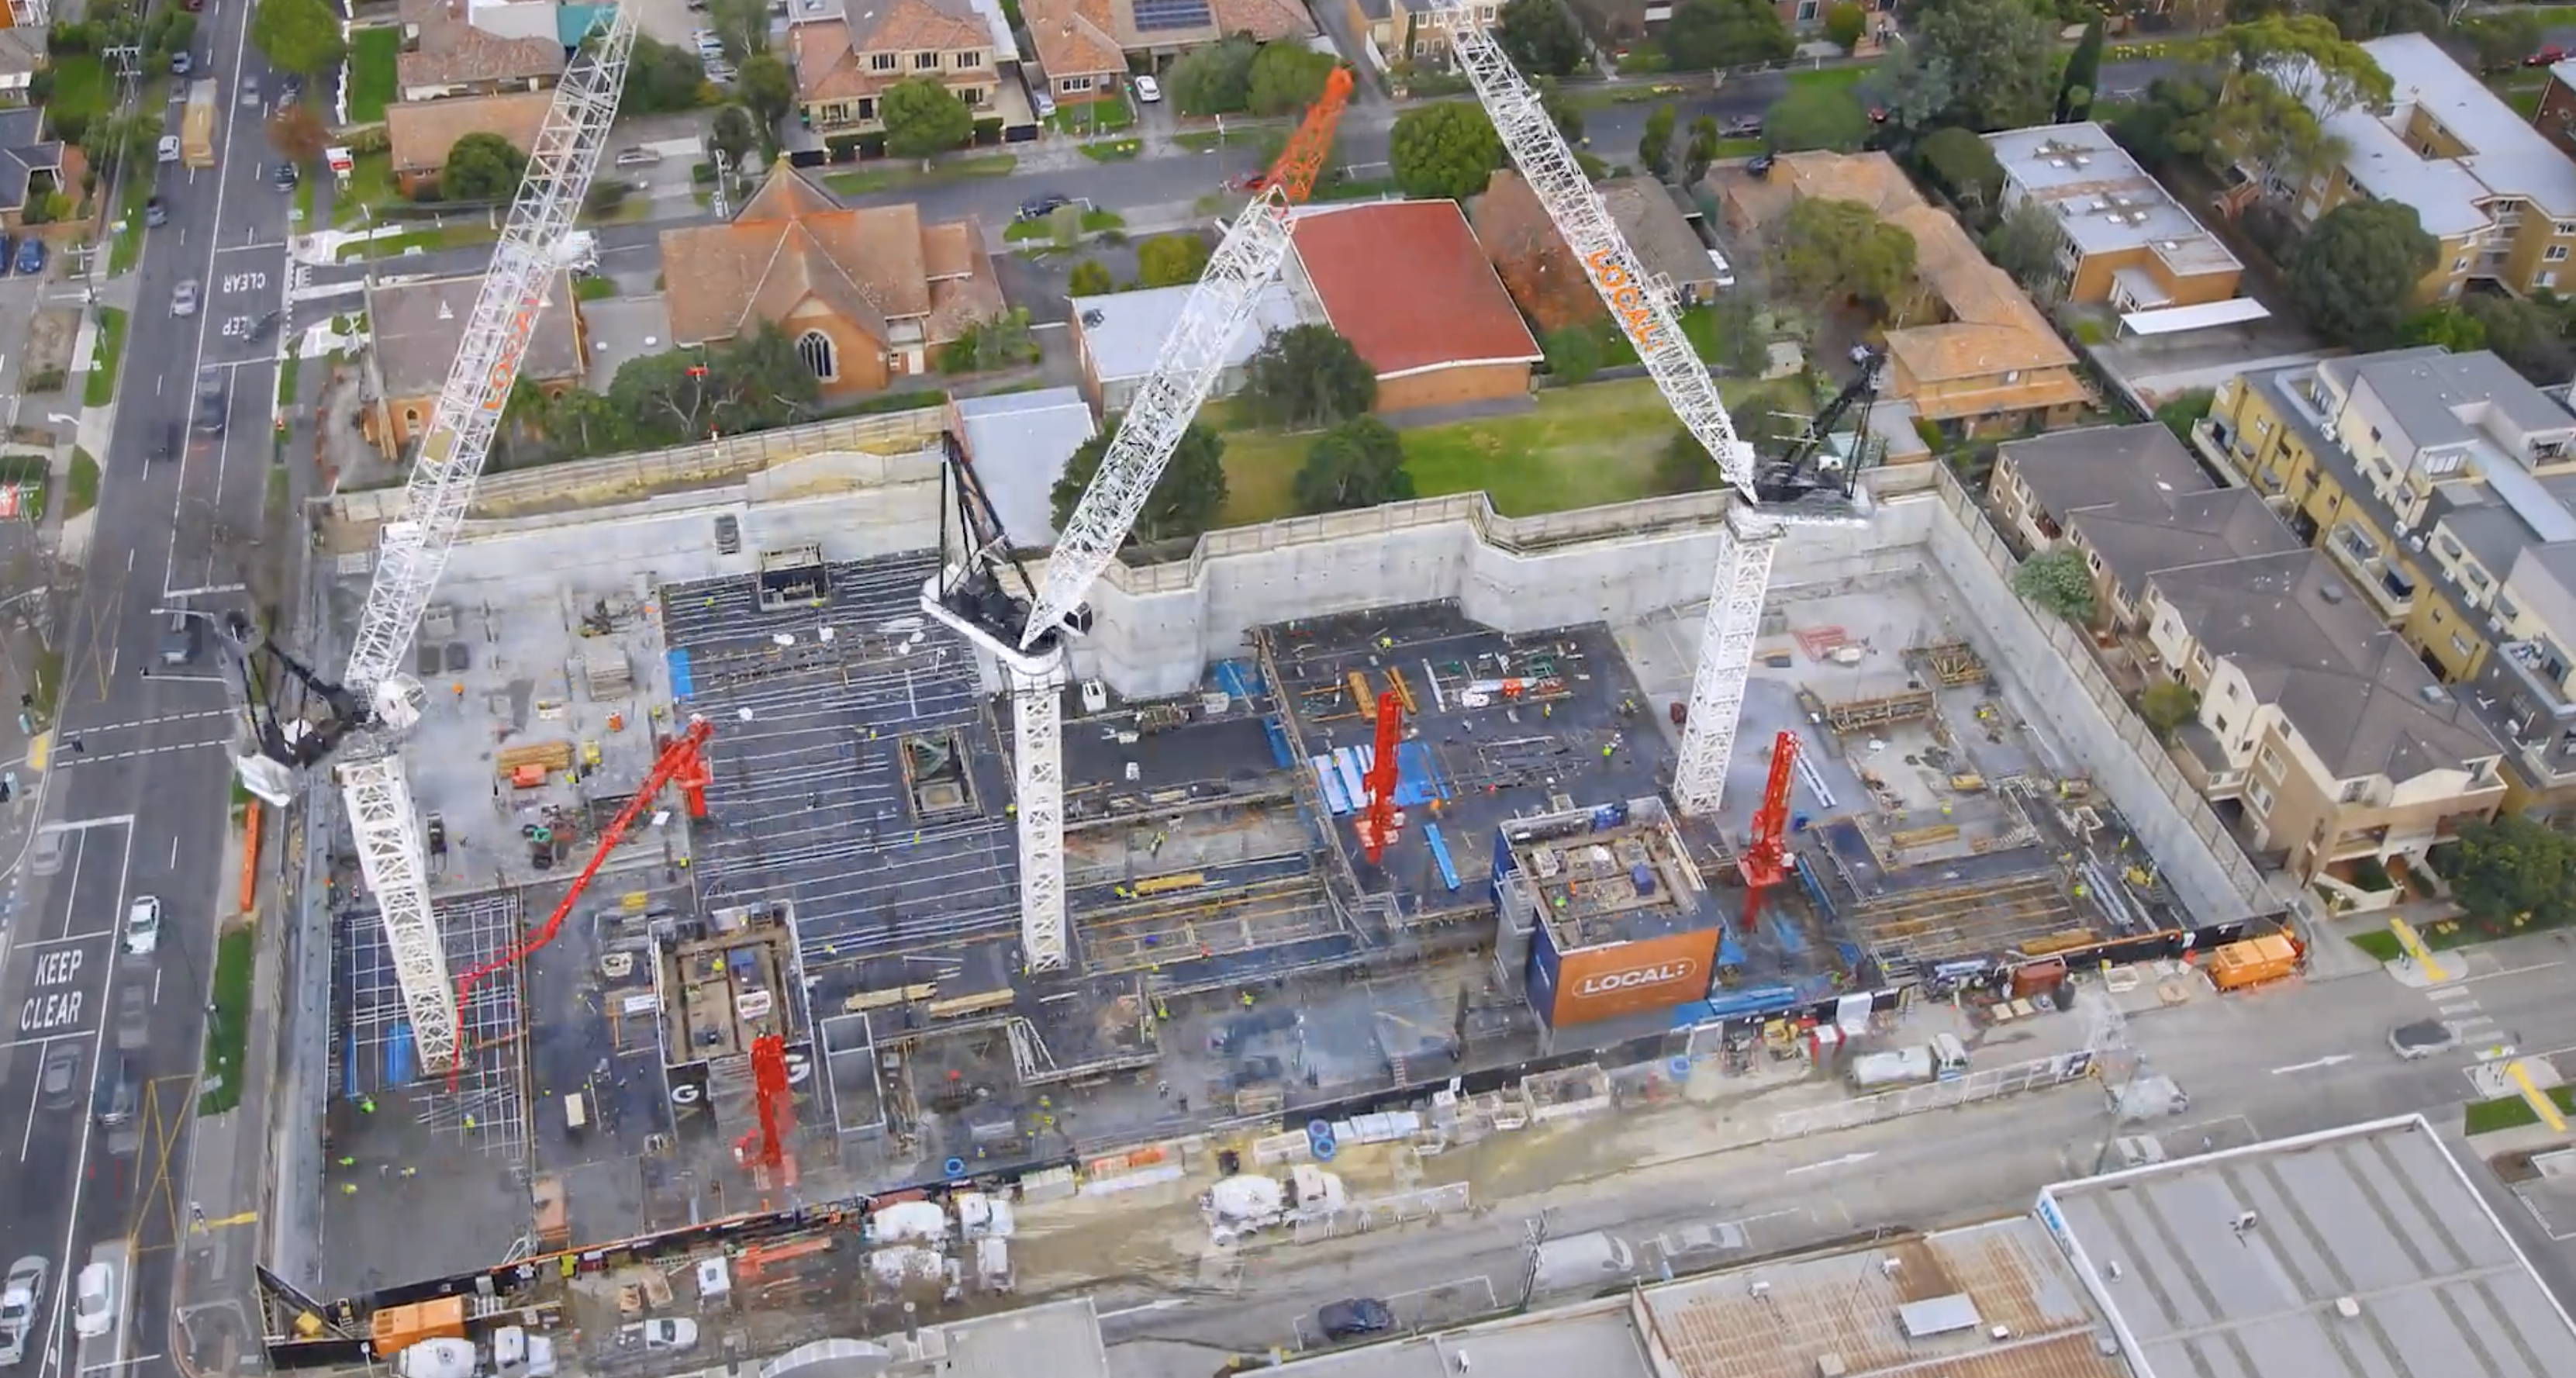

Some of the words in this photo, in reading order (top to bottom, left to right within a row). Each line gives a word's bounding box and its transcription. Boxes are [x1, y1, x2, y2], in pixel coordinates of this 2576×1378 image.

[223, 272, 266, 293] CLEAR
[222, 316, 248, 335] EEP
[35, 949, 82, 986] KEEP
[1584, 965, 1685, 993] LOCAL:
[21, 991, 82, 1031] CLEAR
[672, 1084, 699, 1103] G
